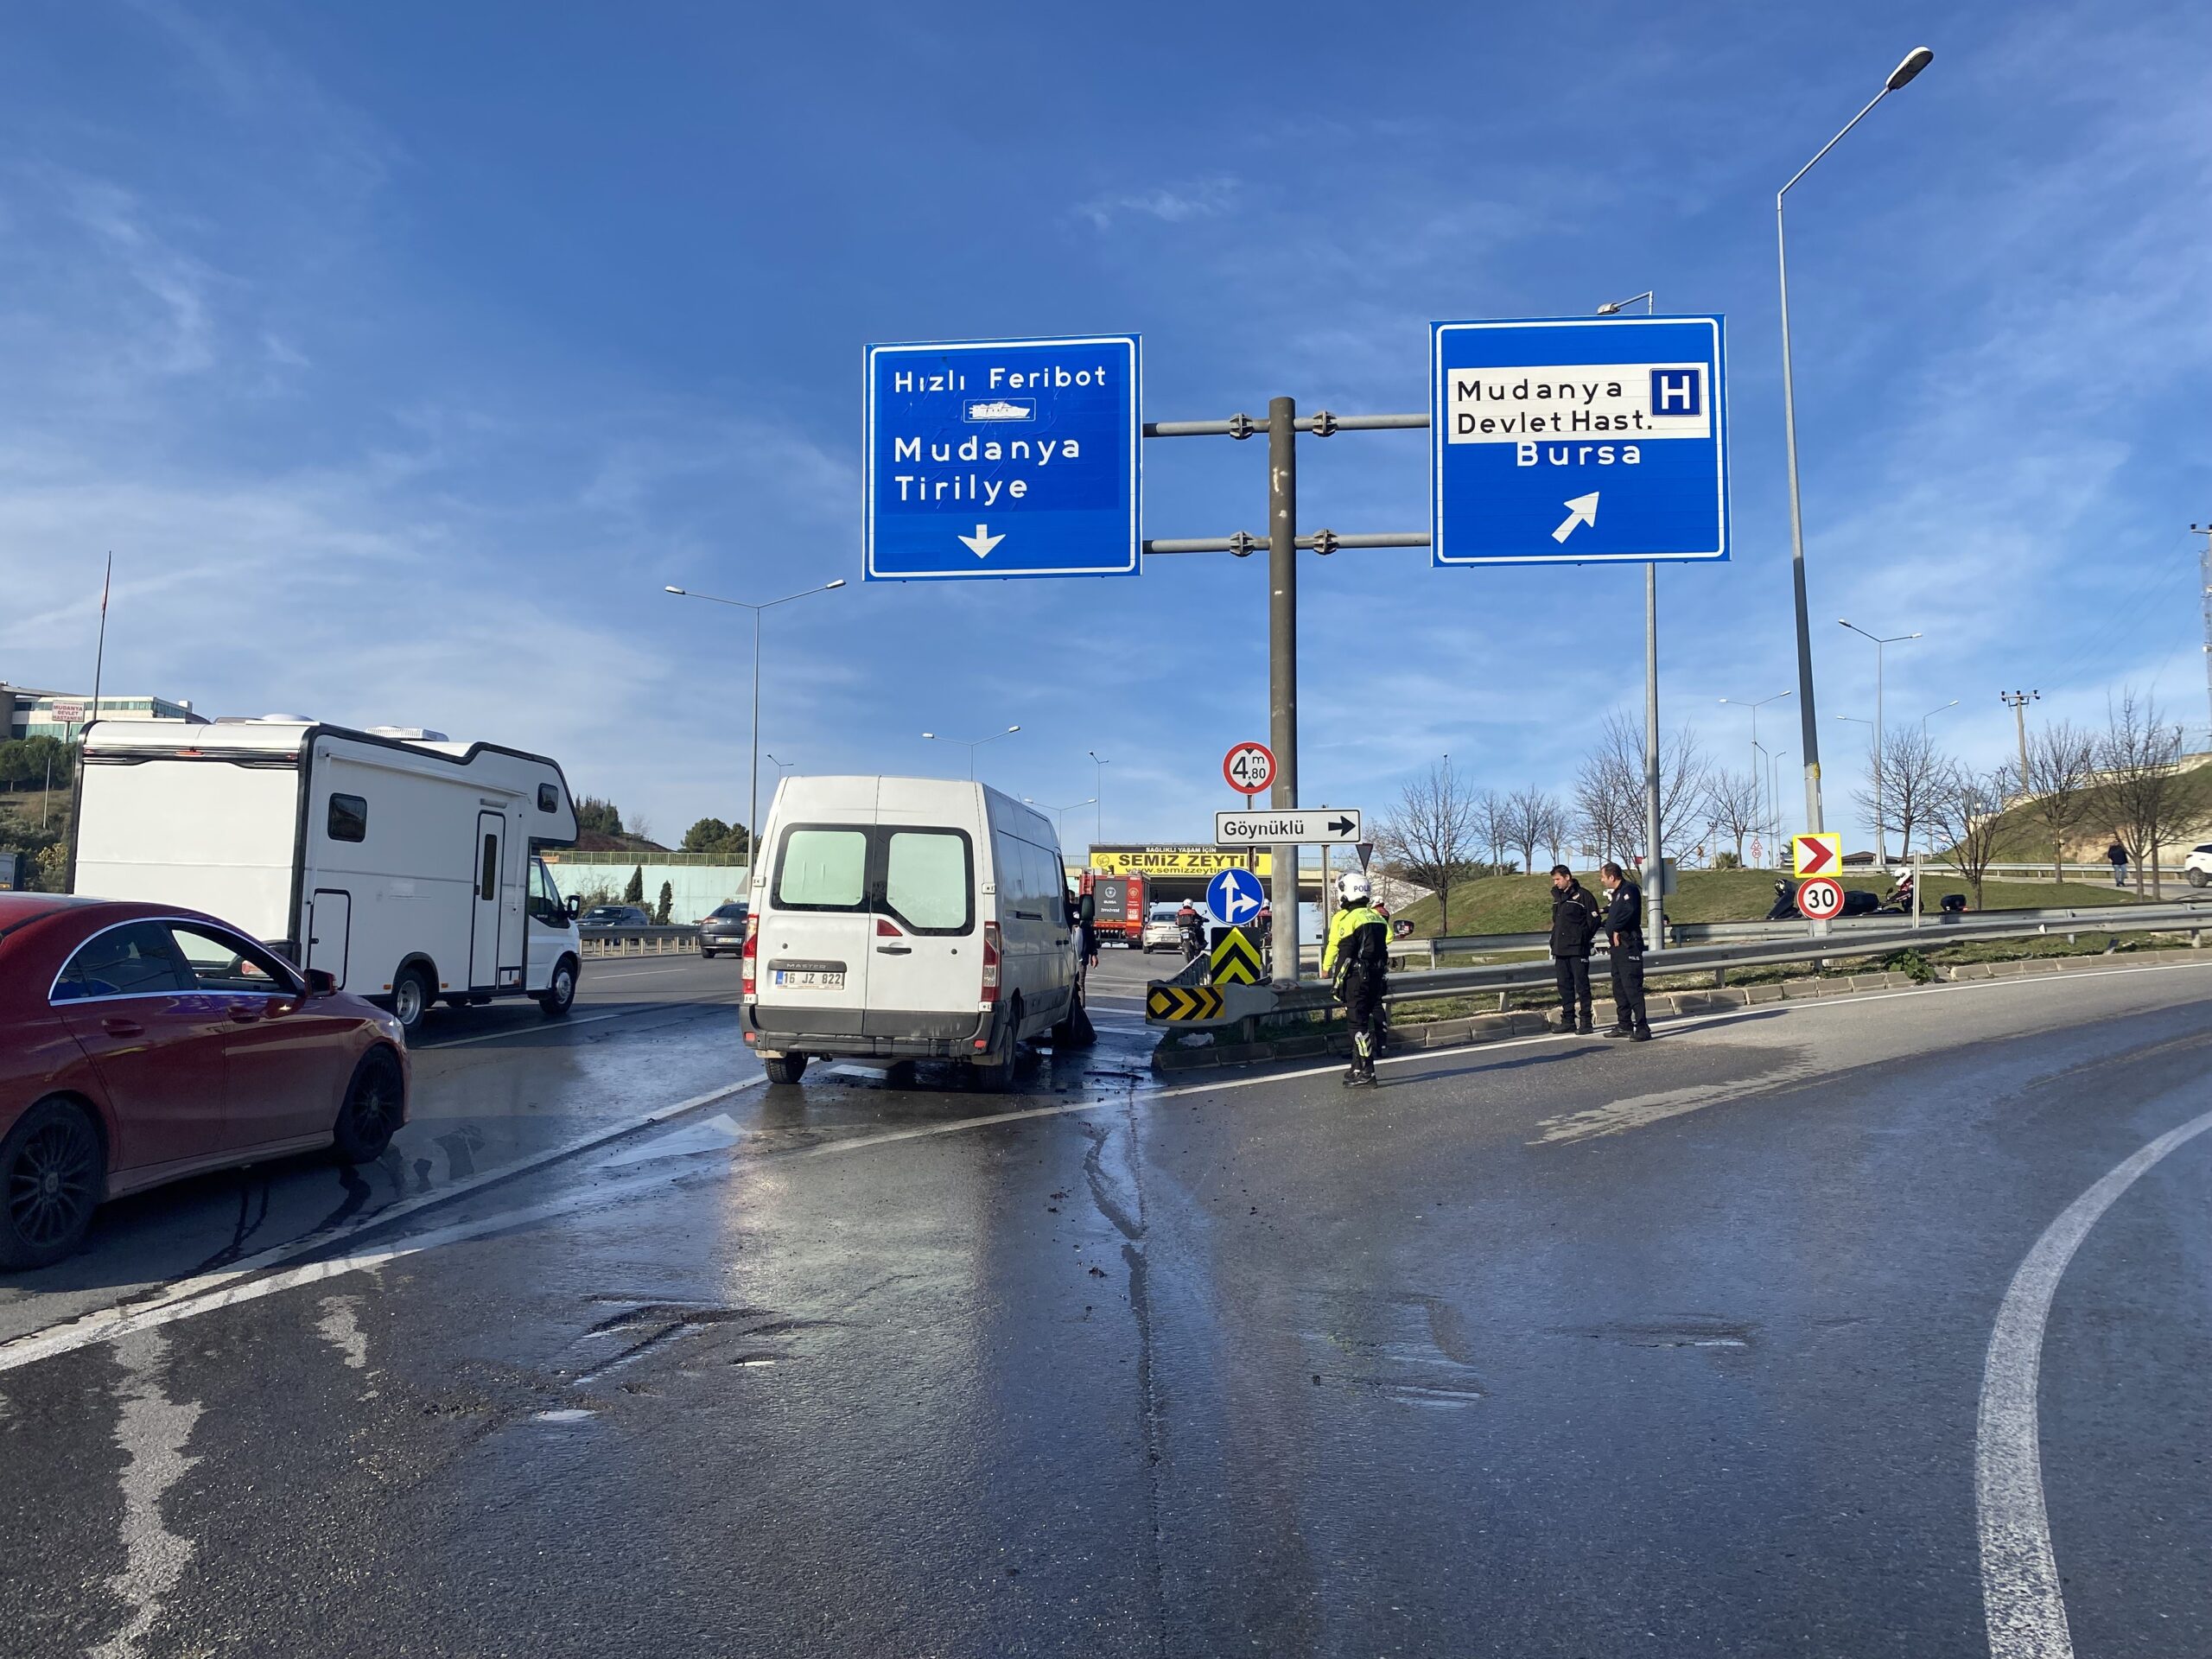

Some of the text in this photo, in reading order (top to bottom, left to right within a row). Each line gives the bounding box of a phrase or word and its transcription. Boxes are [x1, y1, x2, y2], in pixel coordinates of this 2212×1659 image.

[894, 365, 1105, 392] Hızlı Feribot
[1457, 378, 1623, 405] Mudanya
[1457, 409, 1653, 435] Devlet Hast.
[894, 435, 1080, 467] Mudanya
[1516, 441, 1641, 467] Bursa
[894, 474, 1028, 506] Tirilye
[1224, 820, 1305, 839] Göynüklü
[1808, 888, 1834, 909] 30
[784, 973, 796, 984] 16
[802, 973, 815, 984] JZ
[822, 974, 841, 984] 822
